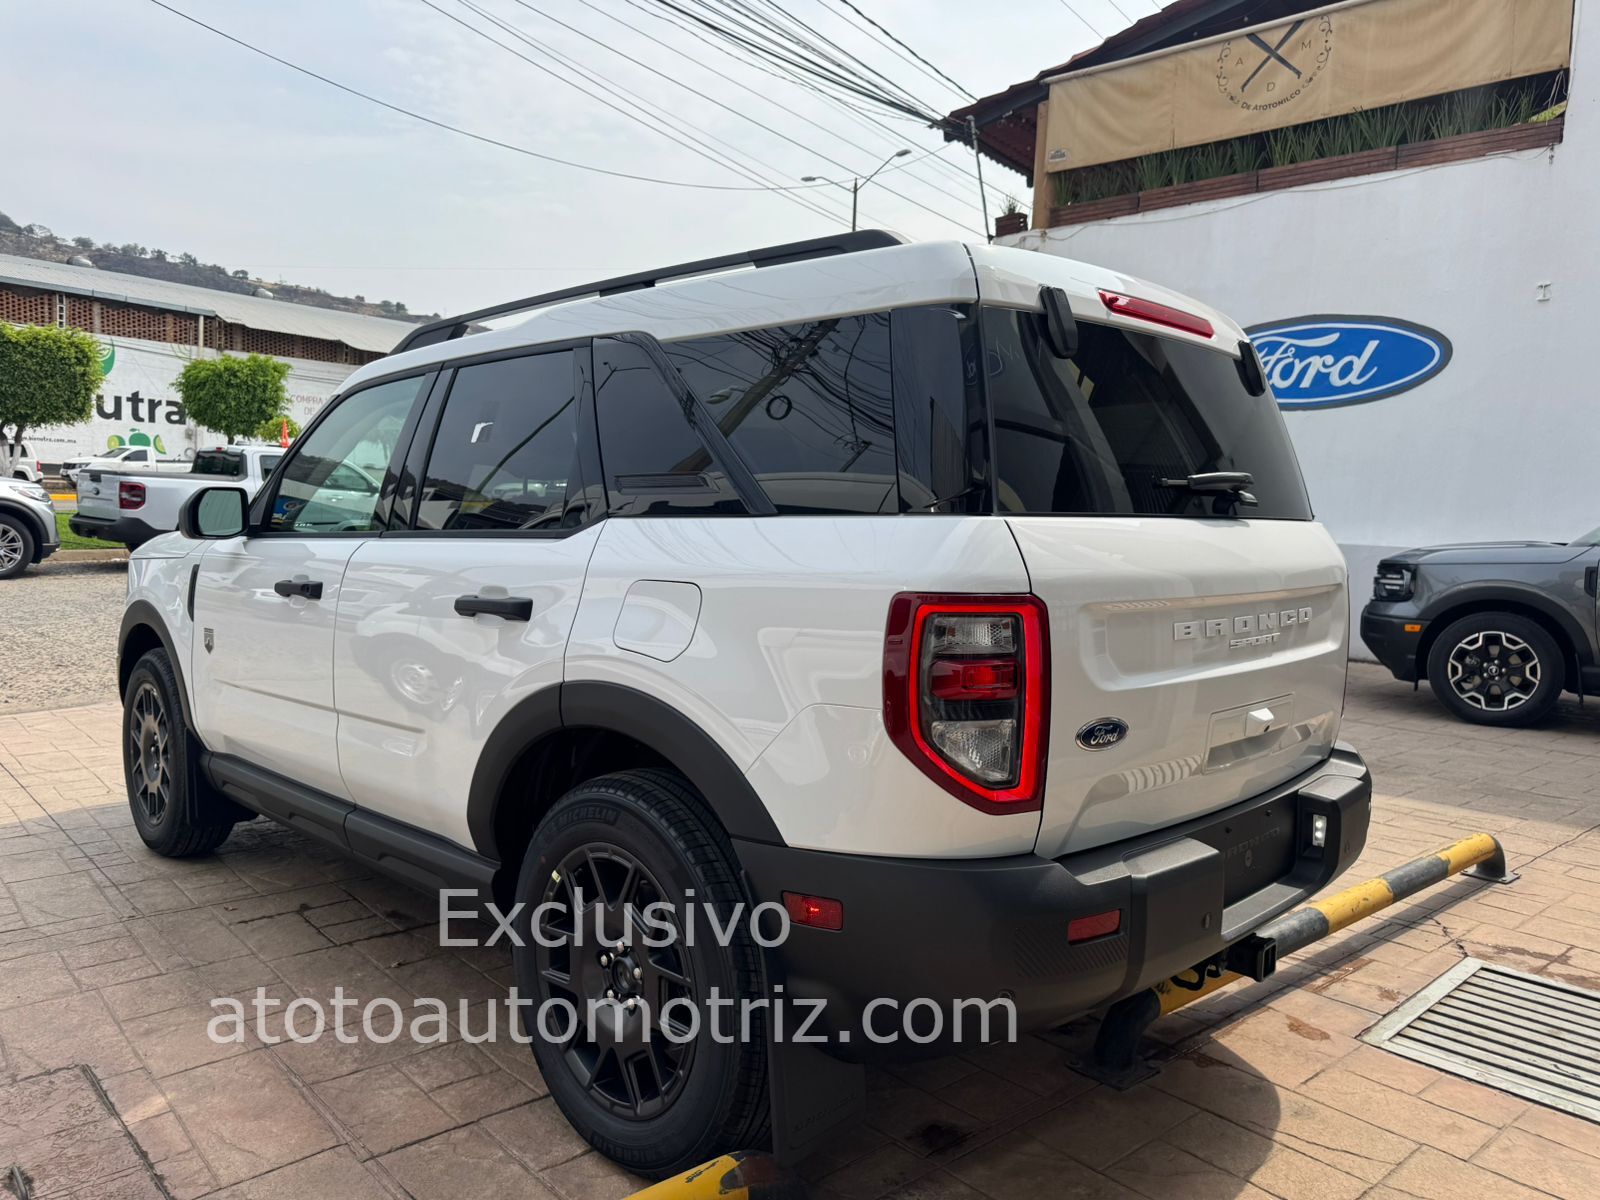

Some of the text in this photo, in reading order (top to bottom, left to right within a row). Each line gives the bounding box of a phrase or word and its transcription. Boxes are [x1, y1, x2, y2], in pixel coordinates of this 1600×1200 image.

[1250, 332, 1380, 389] Ford
[1173, 606, 1313, 641] BRONCO
[1229, 633, 1281, 650] SPORT
[1089, 724, 1121, 745] Ford
[559, 806, 618, 825] MICHELIN
